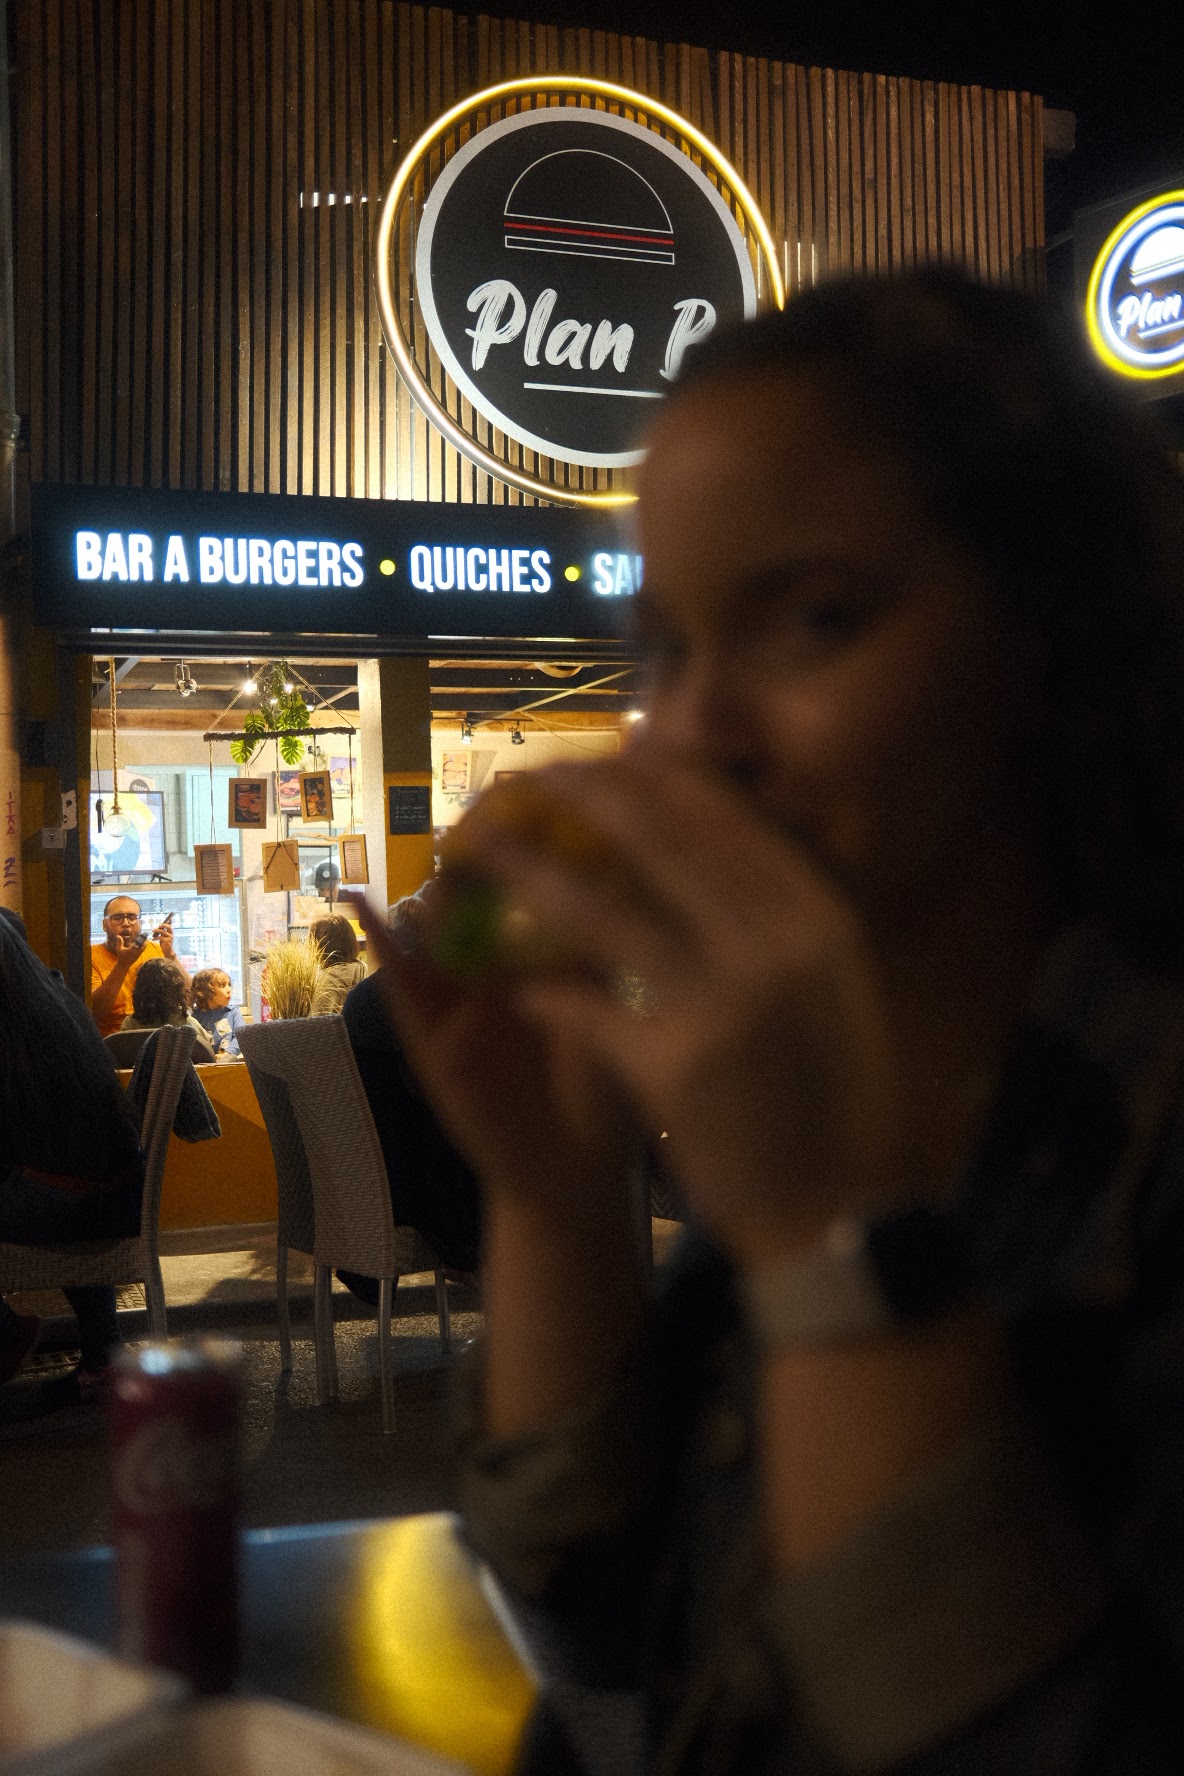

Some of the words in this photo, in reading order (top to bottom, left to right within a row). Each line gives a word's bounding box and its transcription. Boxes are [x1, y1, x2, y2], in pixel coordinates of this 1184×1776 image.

[465, 279, 635, 373] Plan
[1117, 292, 1182, 338] Plan
[76, 531, 154, 581] BAR
[163, 535, 190, 582] A
[199, 537, 364, 587] BURGERS
[410, 545, 551, 593] QUICHES
